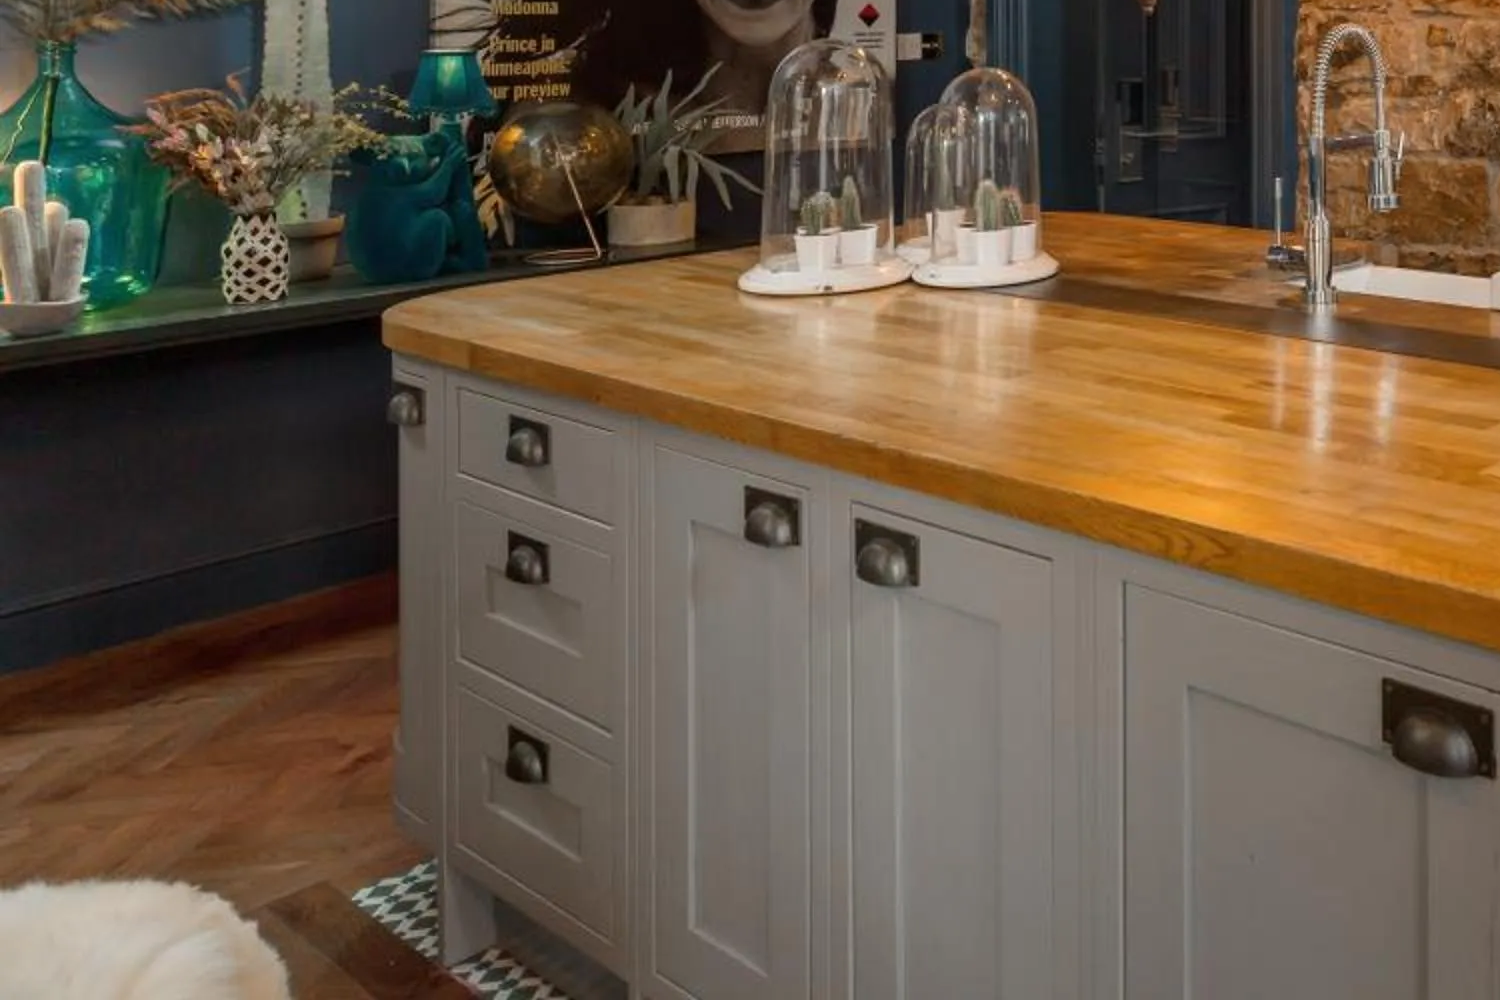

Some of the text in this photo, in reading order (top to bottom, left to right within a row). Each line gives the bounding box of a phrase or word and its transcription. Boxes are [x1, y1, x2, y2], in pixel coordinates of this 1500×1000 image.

[489, 33, 555, 53] Prince in
[513, 80, 571, 102] preview
